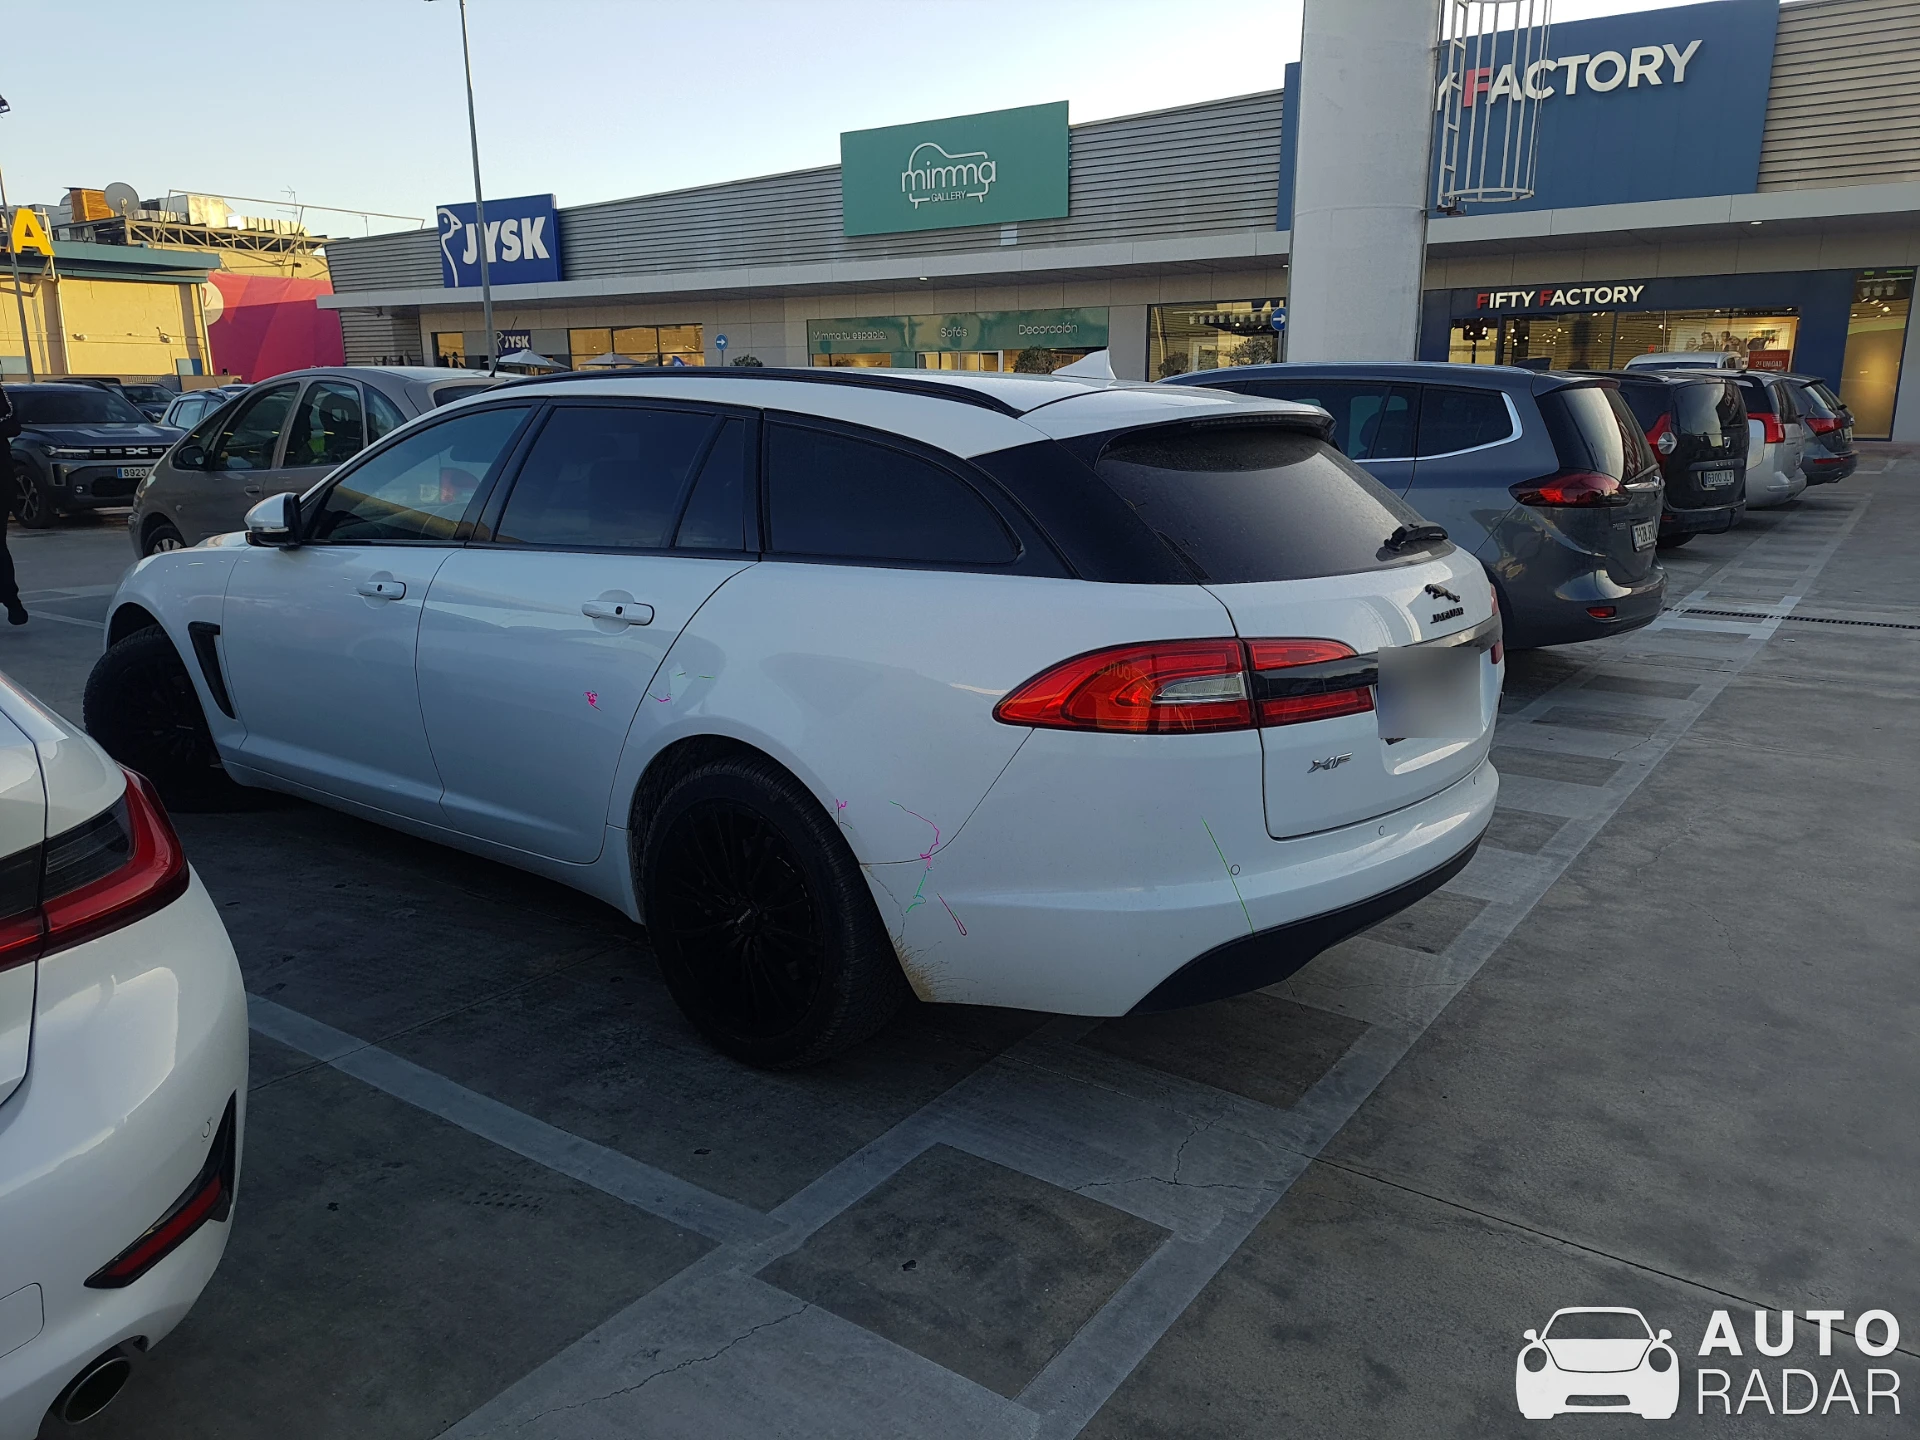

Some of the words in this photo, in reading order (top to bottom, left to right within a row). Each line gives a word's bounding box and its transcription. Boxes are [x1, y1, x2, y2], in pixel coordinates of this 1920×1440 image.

[1463, 39, 1703, 108] FACTORY
[901, 160, 996, 192] mimma
[931, 190, 966, 202] GALLERY
[462, 216, 550, 265] JYSK
[1476, 290, 1535, 309] FIFTY
[1539, 285, 1645, 307] FACTORY
[940, 326, 968, 338] Sofás
[1018, 322, 1078, 335] Decoración
[504, 335, 530, 348] JYSK
[842, 331, 851, 340] tu
[123, 468, 147, 477] 8923
[1306, 752, 1353, 774] XF
